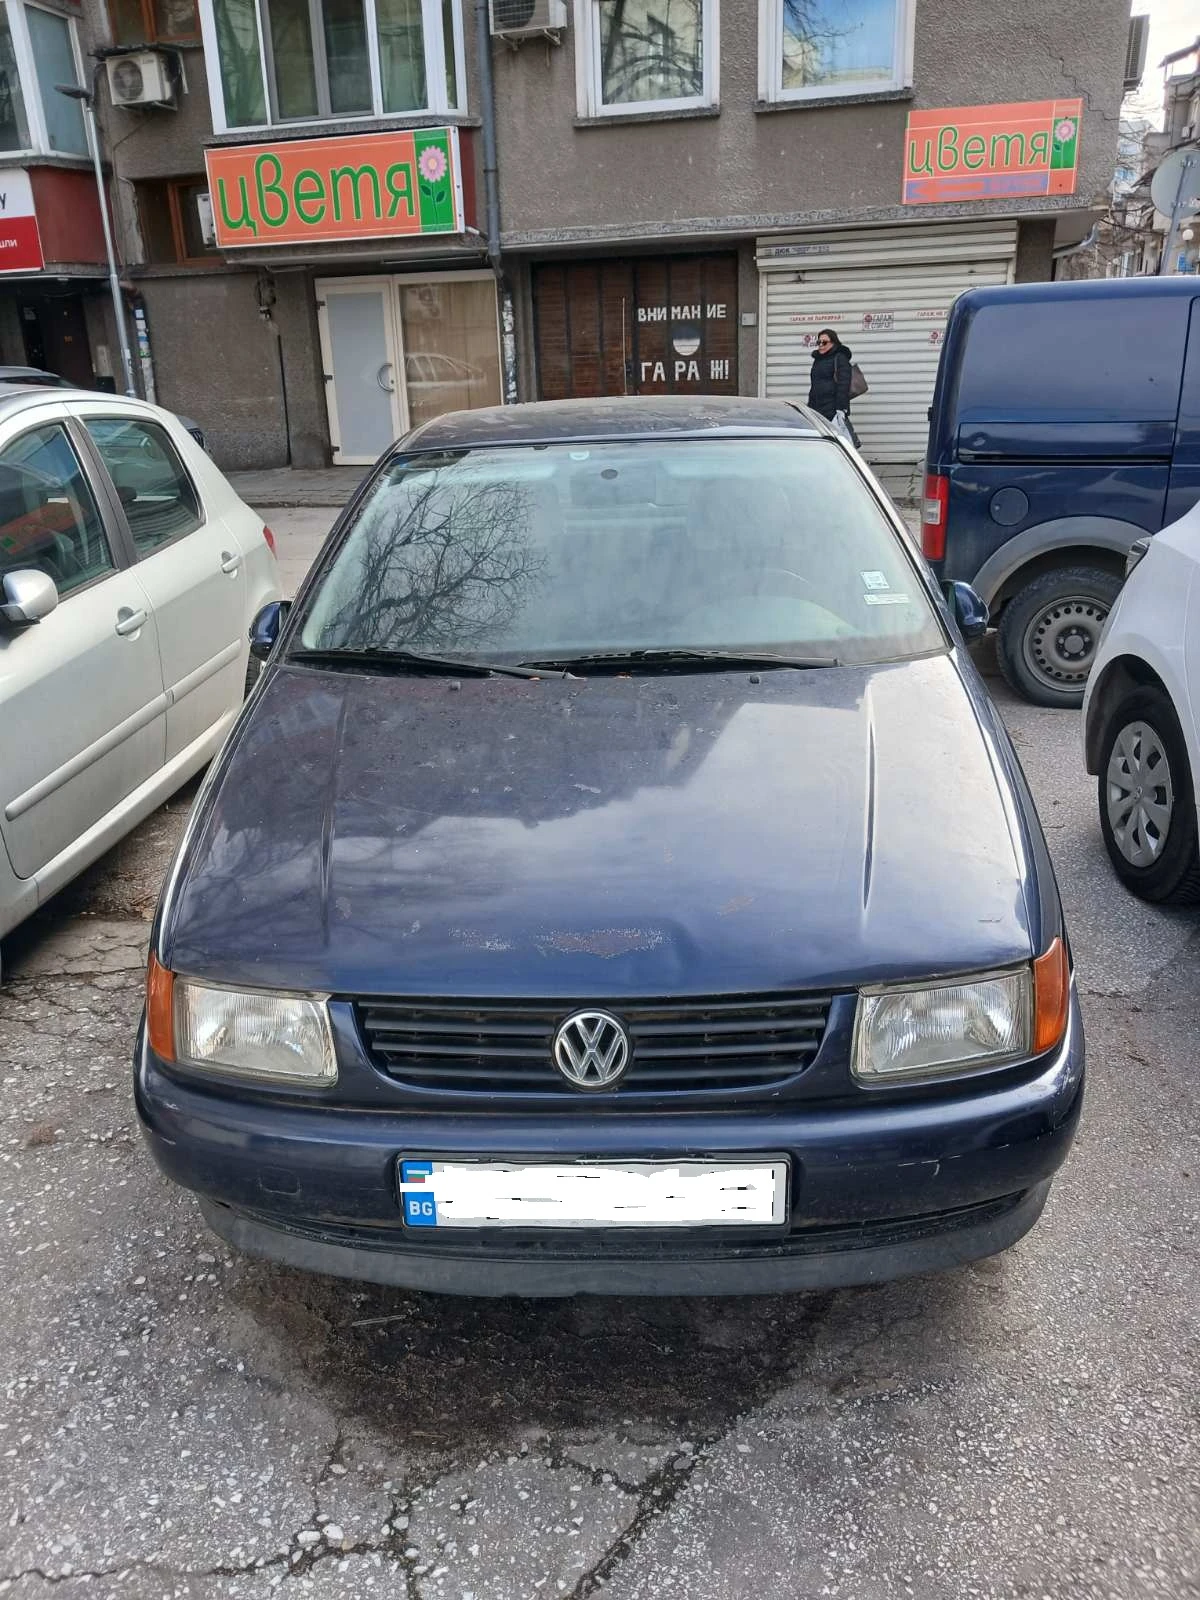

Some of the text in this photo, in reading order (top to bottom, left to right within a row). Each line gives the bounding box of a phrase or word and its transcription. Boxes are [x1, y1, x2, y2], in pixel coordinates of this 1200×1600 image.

[909, 126, 1049, 176] цветя
[217, 152, 416, 238] цветя
[409, 1200, 433, 1216] BG
